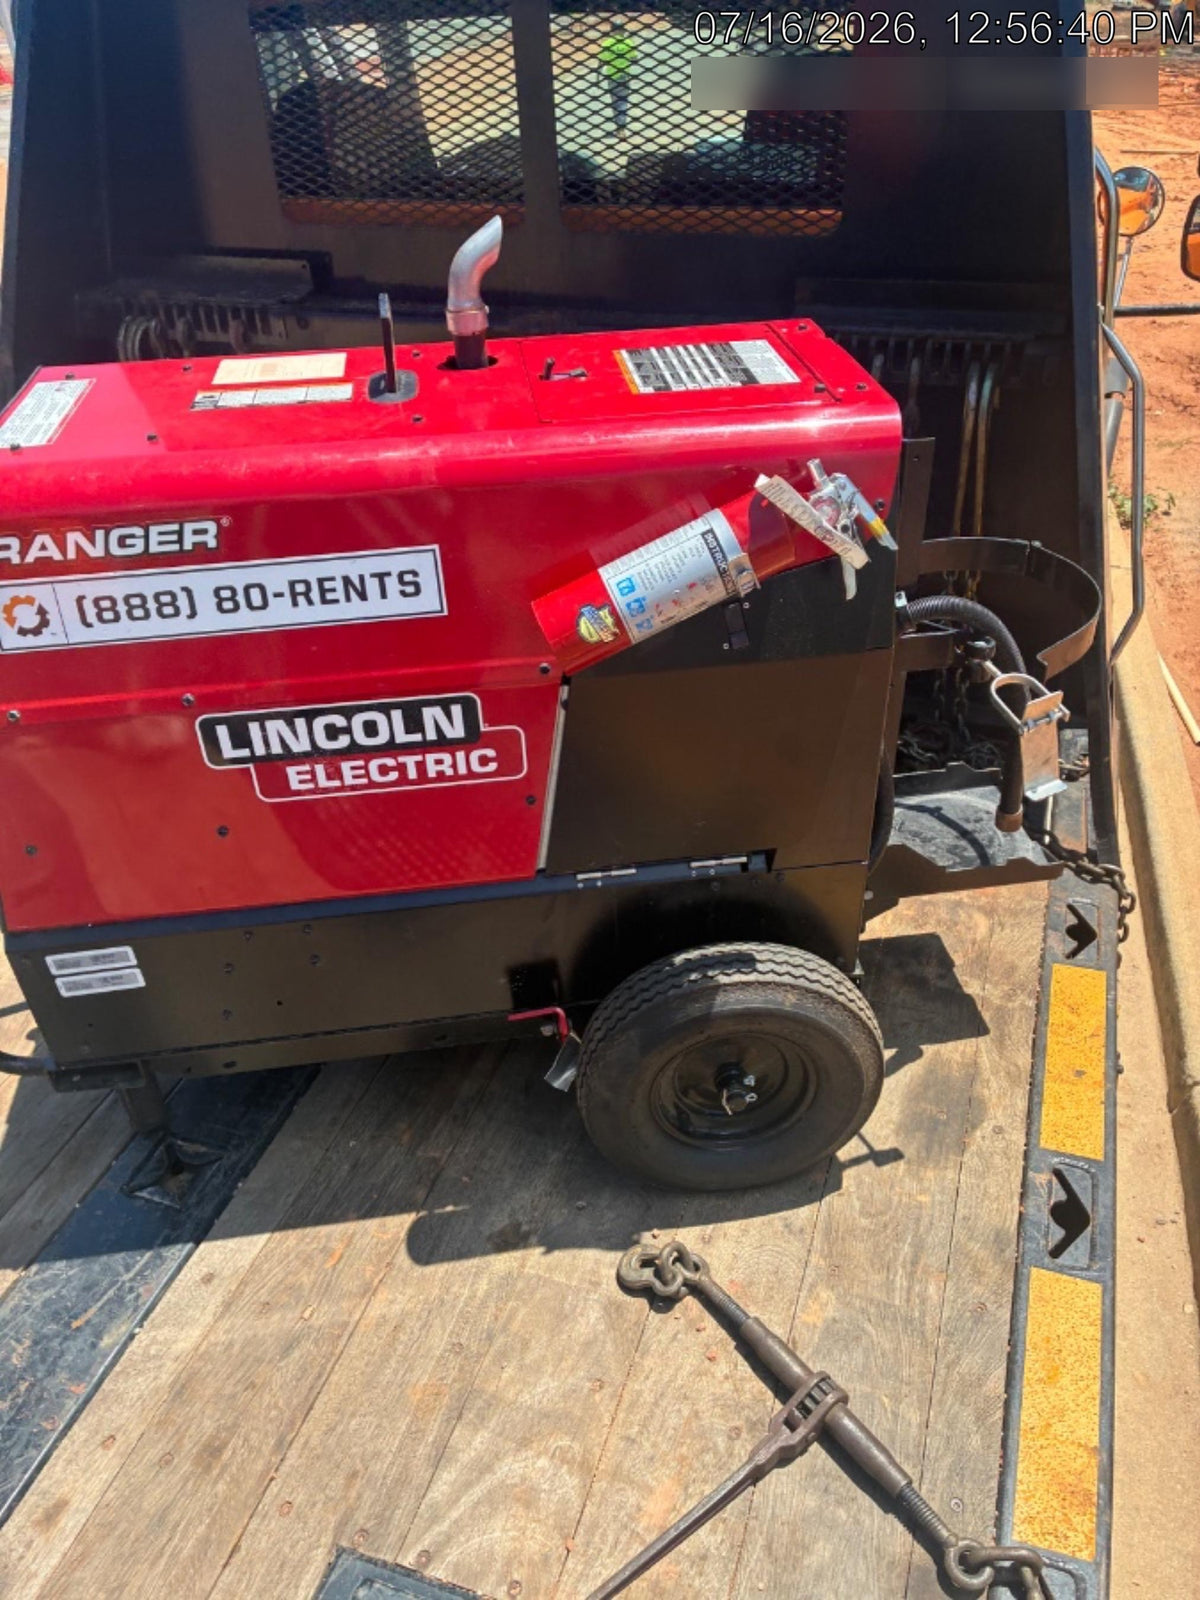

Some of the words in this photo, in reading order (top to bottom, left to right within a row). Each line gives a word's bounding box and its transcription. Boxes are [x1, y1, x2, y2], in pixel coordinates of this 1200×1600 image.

[75, 585, 198, 628] (888)
[213, 568, 422, 614] 80-RENTS
[215, 703, 465, 760] LINCOLN
[286, 748, 499, 791] ELECTRIC
